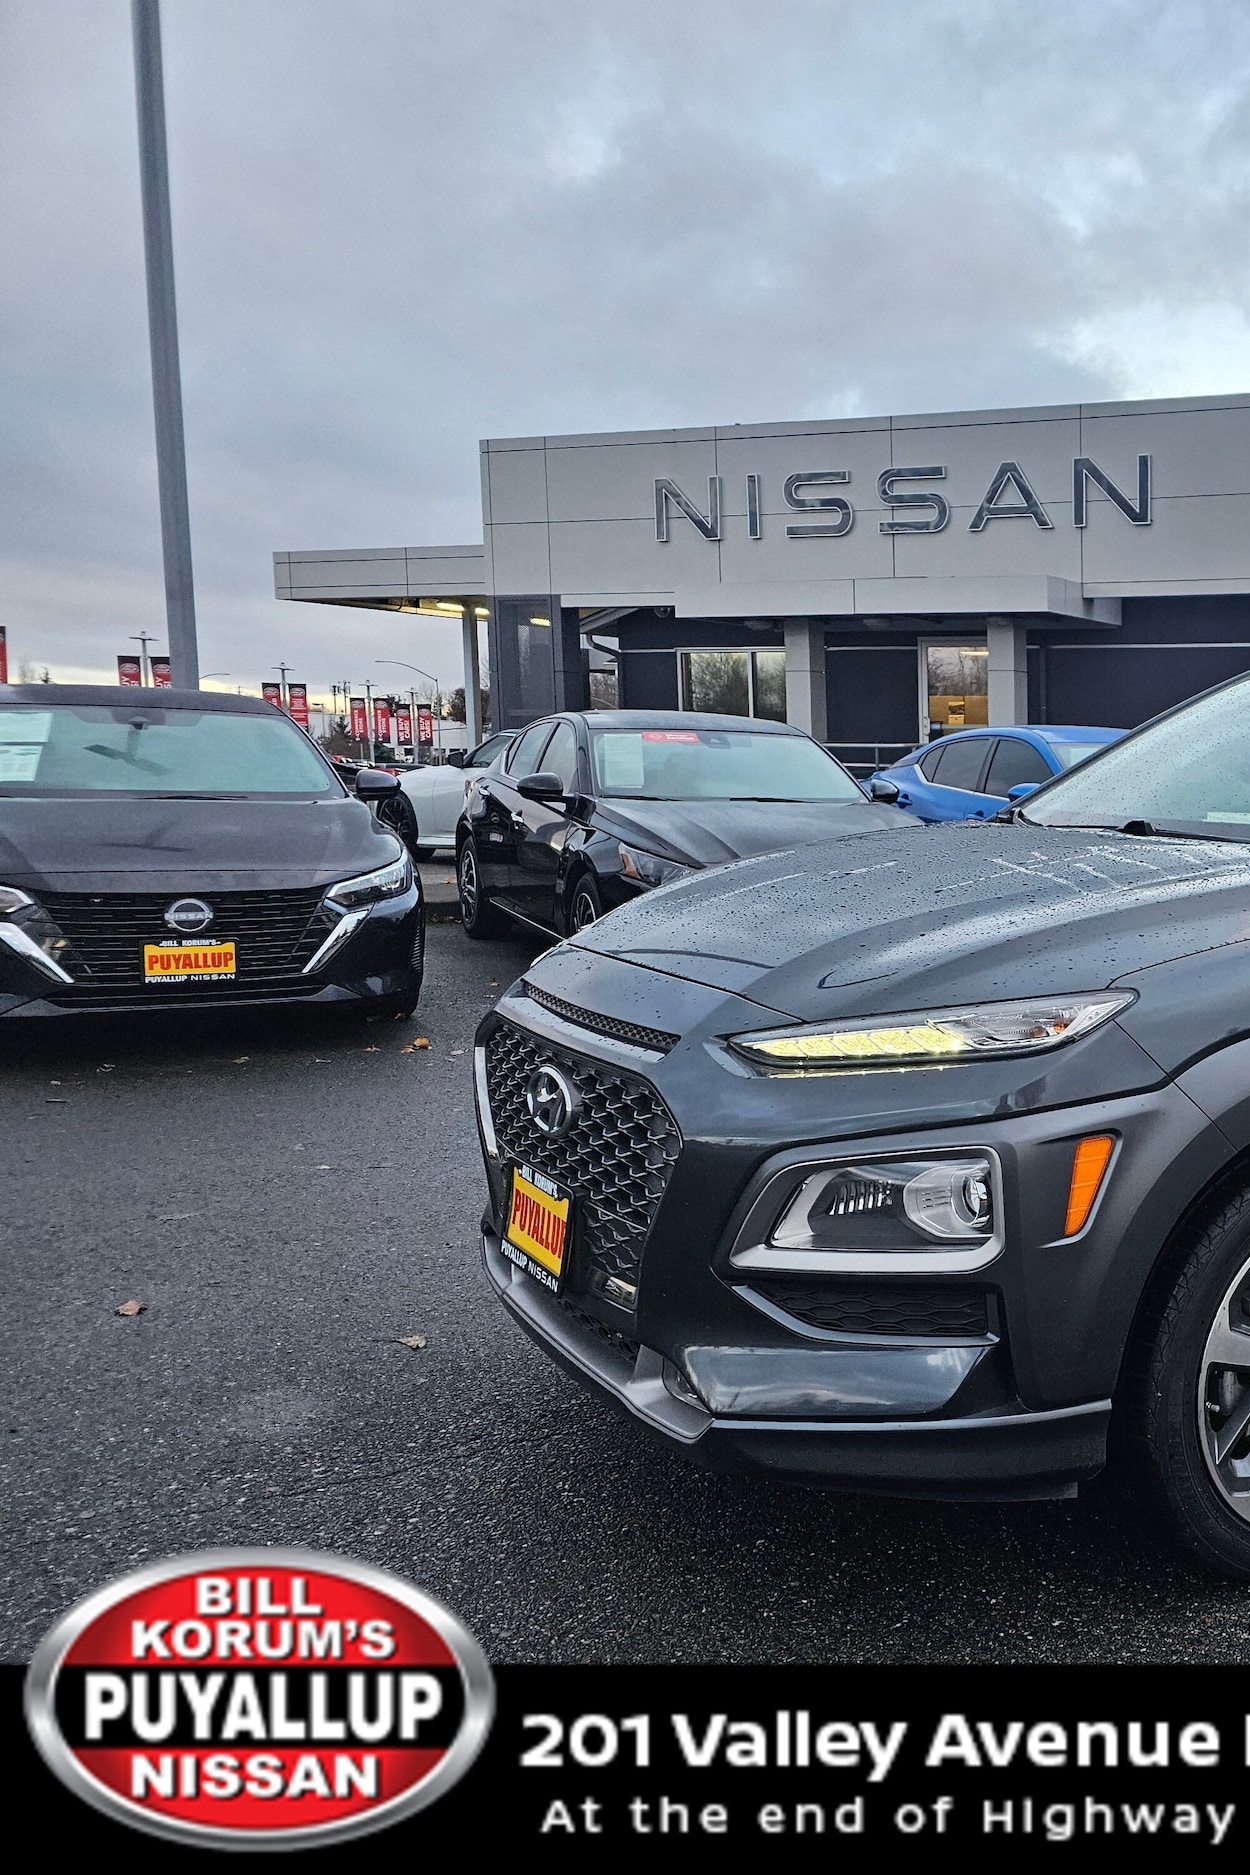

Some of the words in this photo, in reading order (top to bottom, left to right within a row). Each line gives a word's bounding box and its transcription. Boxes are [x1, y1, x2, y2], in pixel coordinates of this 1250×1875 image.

[652, 454, 1152, 542] NISSAN
[165, 911, 214, 921] NISSAN
[147, 951, 234, 971] PUYALLUP
[145, 976, 188, 984] PUYALLUP
[521, 1164, 533, 1182] BILL
[501, 1239, 528, 1269] PUYALLUP
[528, 1260, 559, 1293] NISSAN
